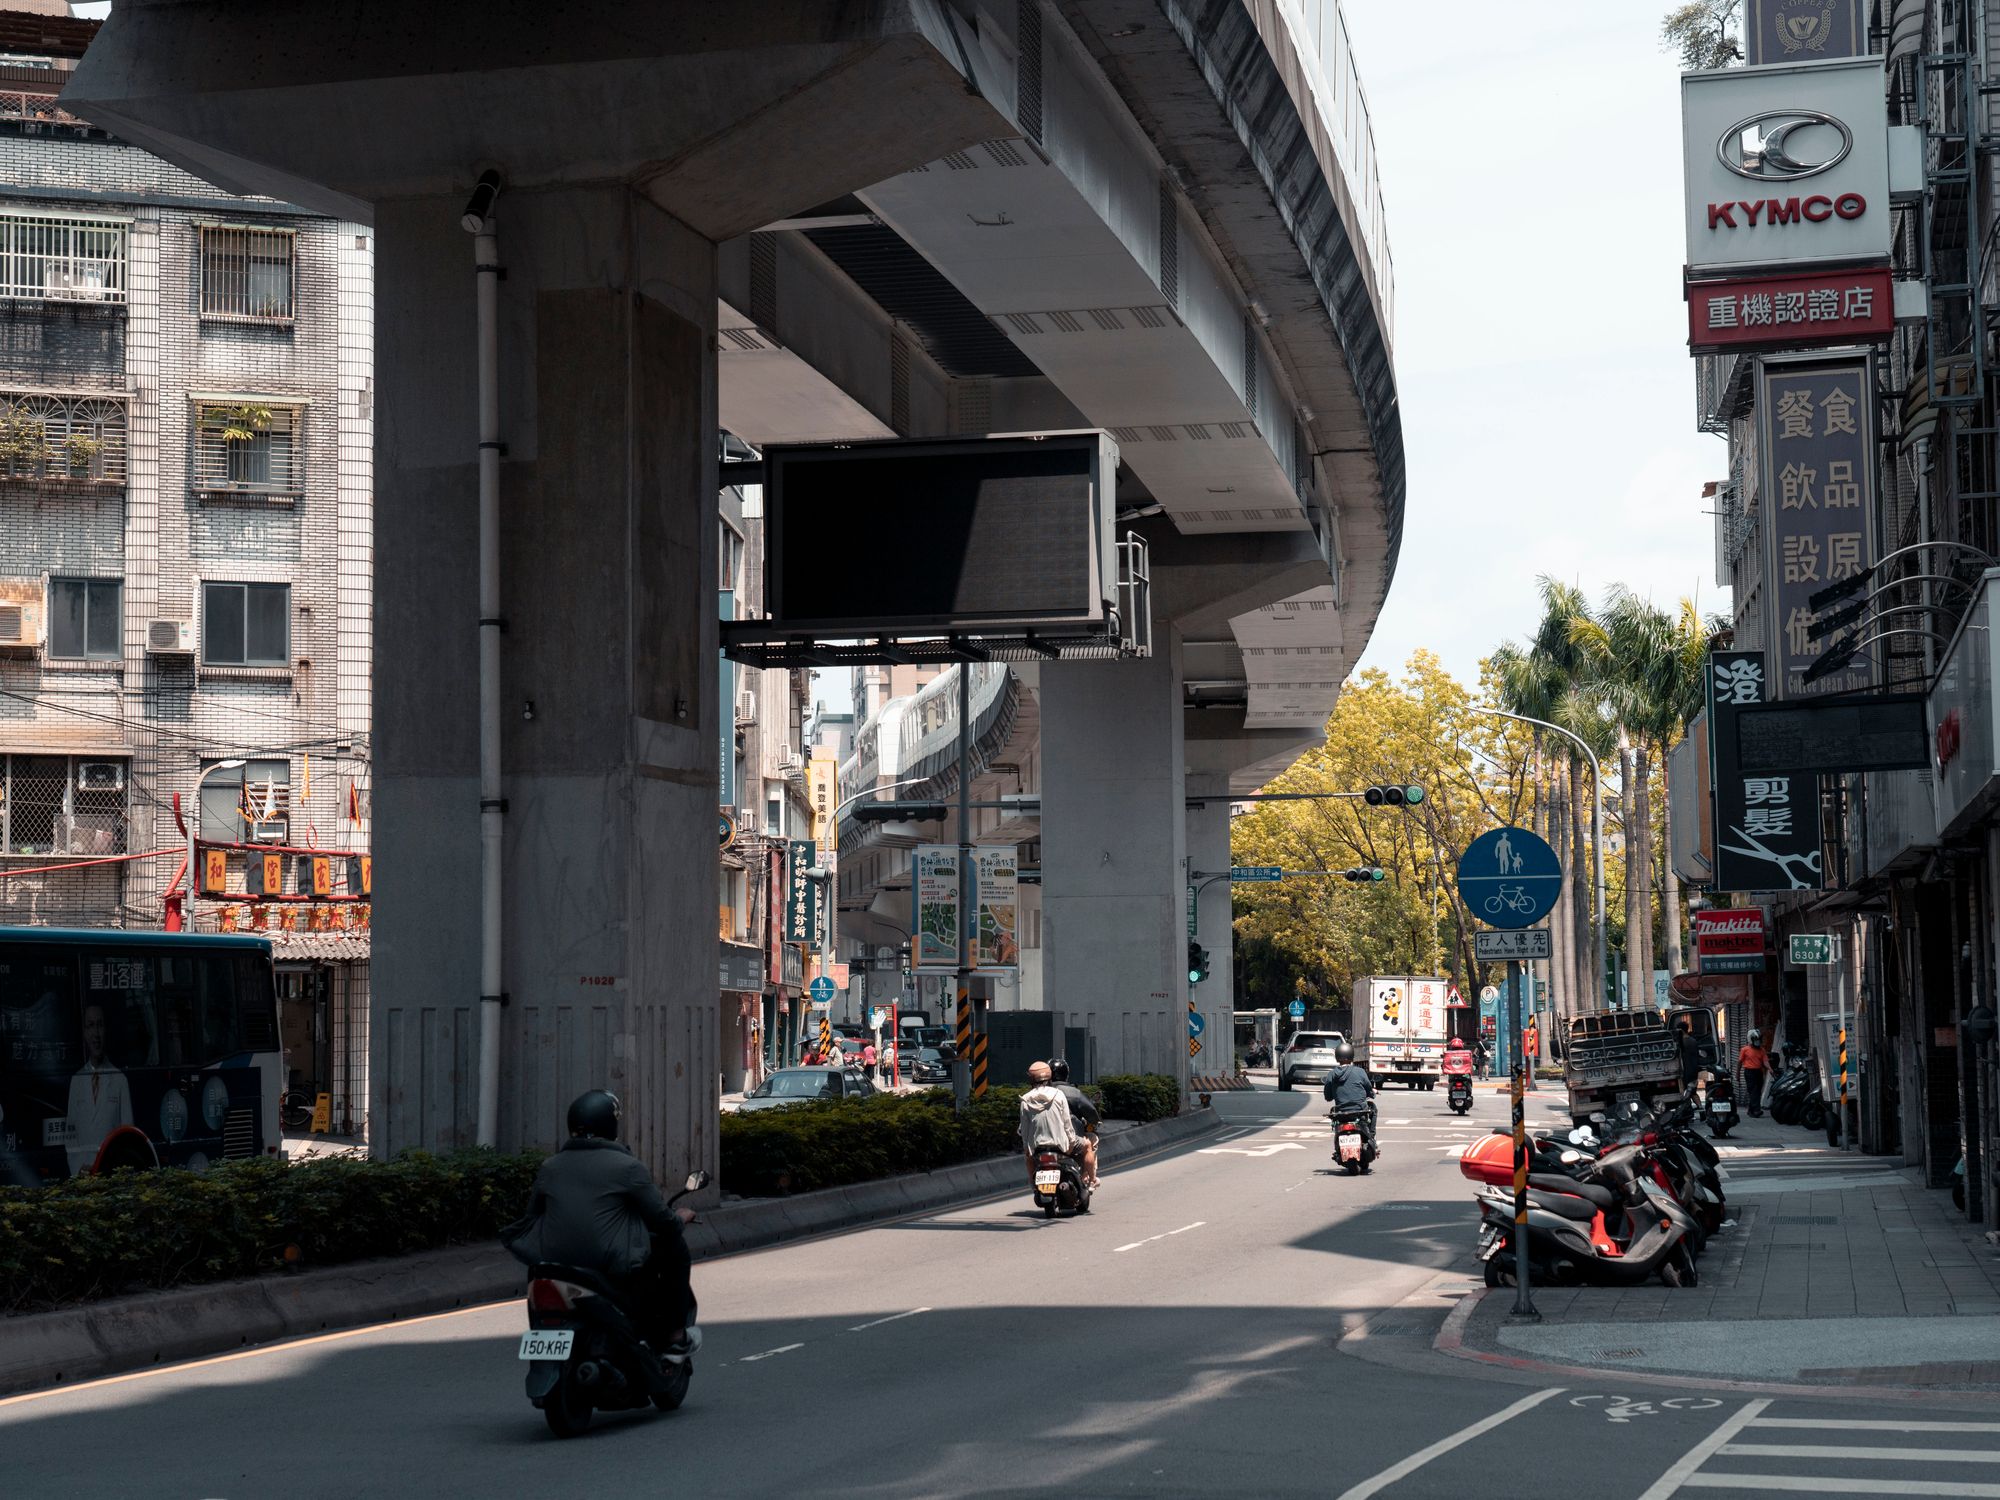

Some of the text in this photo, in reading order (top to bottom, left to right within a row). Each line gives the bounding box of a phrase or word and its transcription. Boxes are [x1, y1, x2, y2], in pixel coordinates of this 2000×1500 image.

[1708, 192, 1867, 229] KYMCO
[1707, 286, 1874, 329] 重機認證店
[1776, 390, 1823, 656] 餐飲設備
[1714, 658, 1764, 705] 澄
[1742, 776, 1793, 836] 剪髮
[1478, 932, 1546, 947] 行人優先
[90, 963, 144, 989] 臺北客運
[580, 976, 615, 985] P1020
